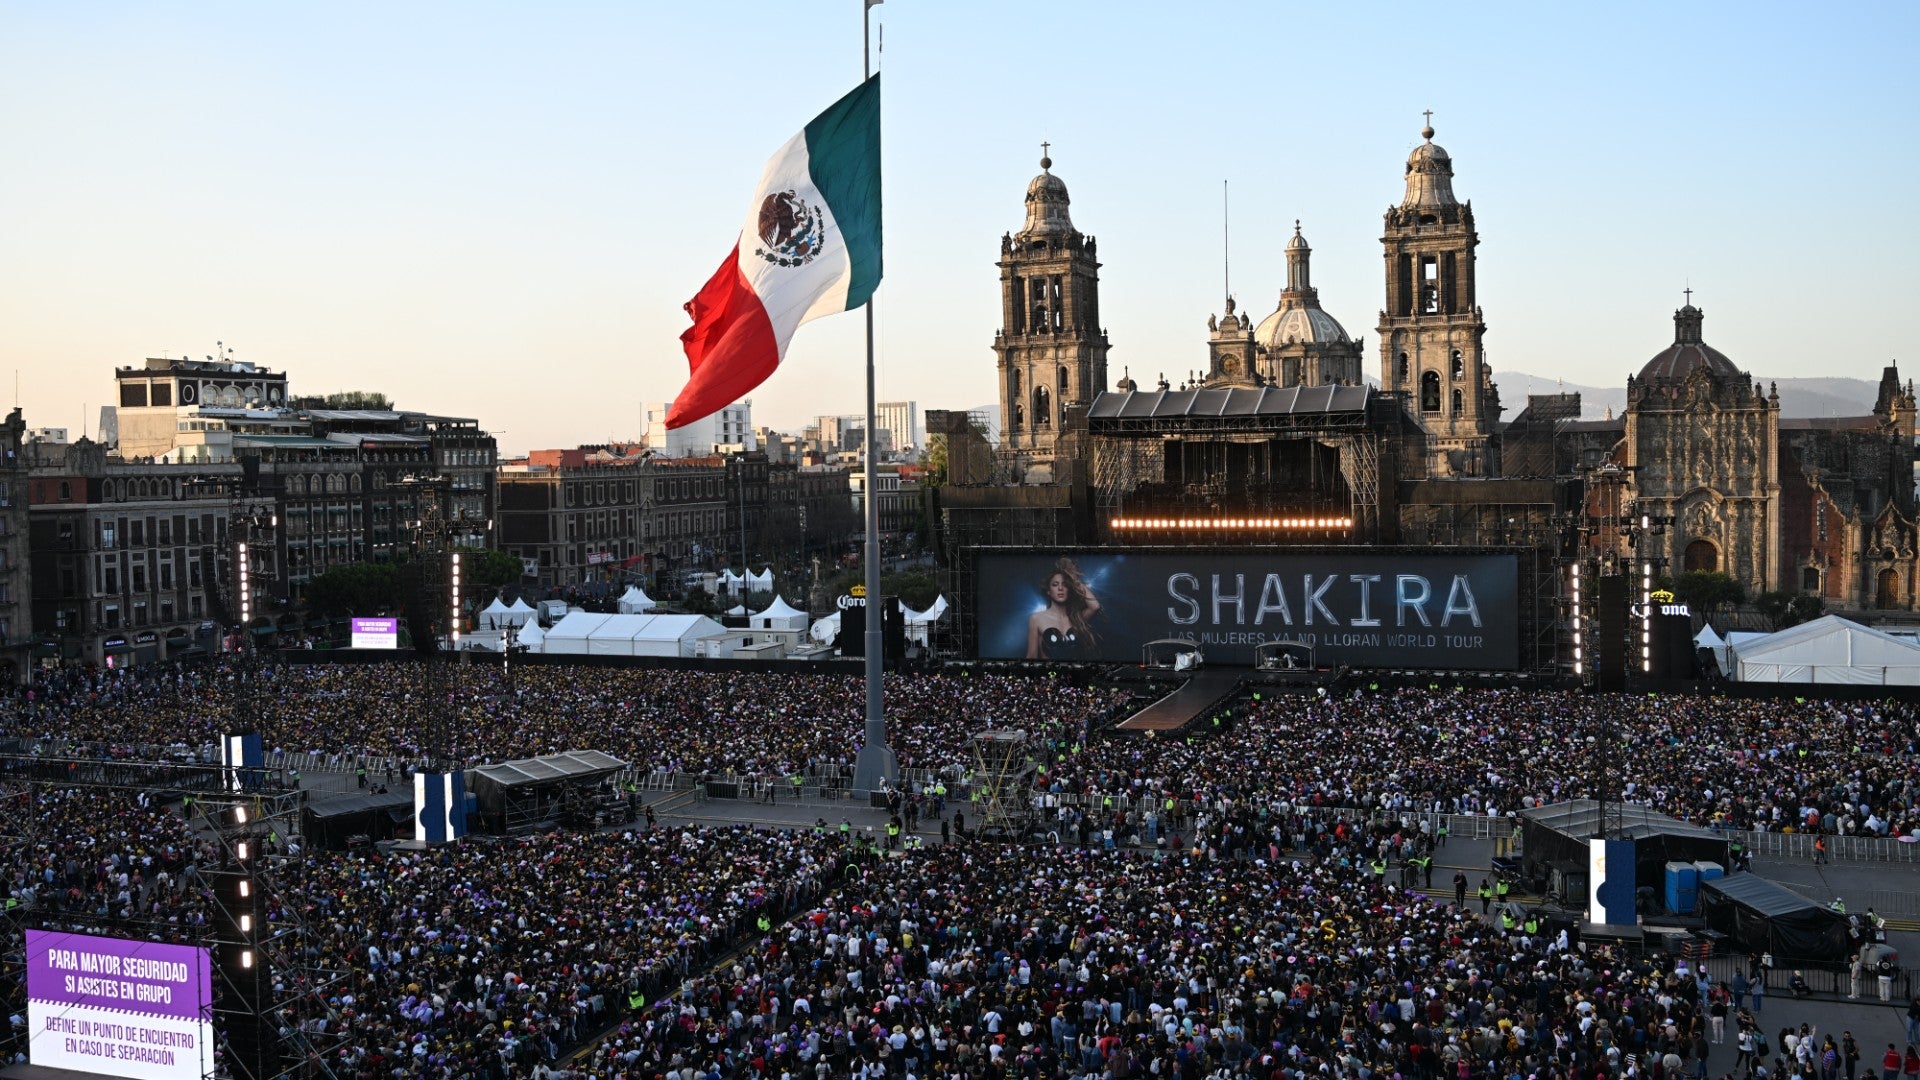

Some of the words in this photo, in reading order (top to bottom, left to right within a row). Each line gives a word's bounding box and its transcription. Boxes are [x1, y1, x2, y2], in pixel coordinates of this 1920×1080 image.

[836, 595, 866, 610] Coro
[1167, 573, 1482, 626] SHAKIRA
[1201, 632, 1265, 645] MUJERES
[1273, 632, 1290, 642] YA
[1298, 632, 1316, 645] NO
[1324, 633, 1381, 646] LLORAN
[1387, 634, 1436, 647] WORLD
[1444, 635, 1483, 648] TOUR
[49, 949, 78, 970] PARA
[81, 953, 120, 975] MAYOR
[123, 957, 187, 982] SEGURIDAD
[65, 976, 75, 993] SI
[78, 977, 118, 998] ASISTES
[121, 983, 134, 1000] EN
[137, 984, 171, 1004] GRUPO
[46, 1016, 76, 1034] DEFINE
[79, 1020, 91, 1036] UN
[94, 1022, 122, 1040] PUNTO
[126, 1027, 137, 1042] DE
[140, 1028, 194, 1049] ENCUENTRO
[66, 1038, 77, 1053] EN
[79, 1040, 102, 1056] CASO
[105, 1042, 116, 1058] DE
[119, 1044, 174, 1066] SEPARACIÓN
